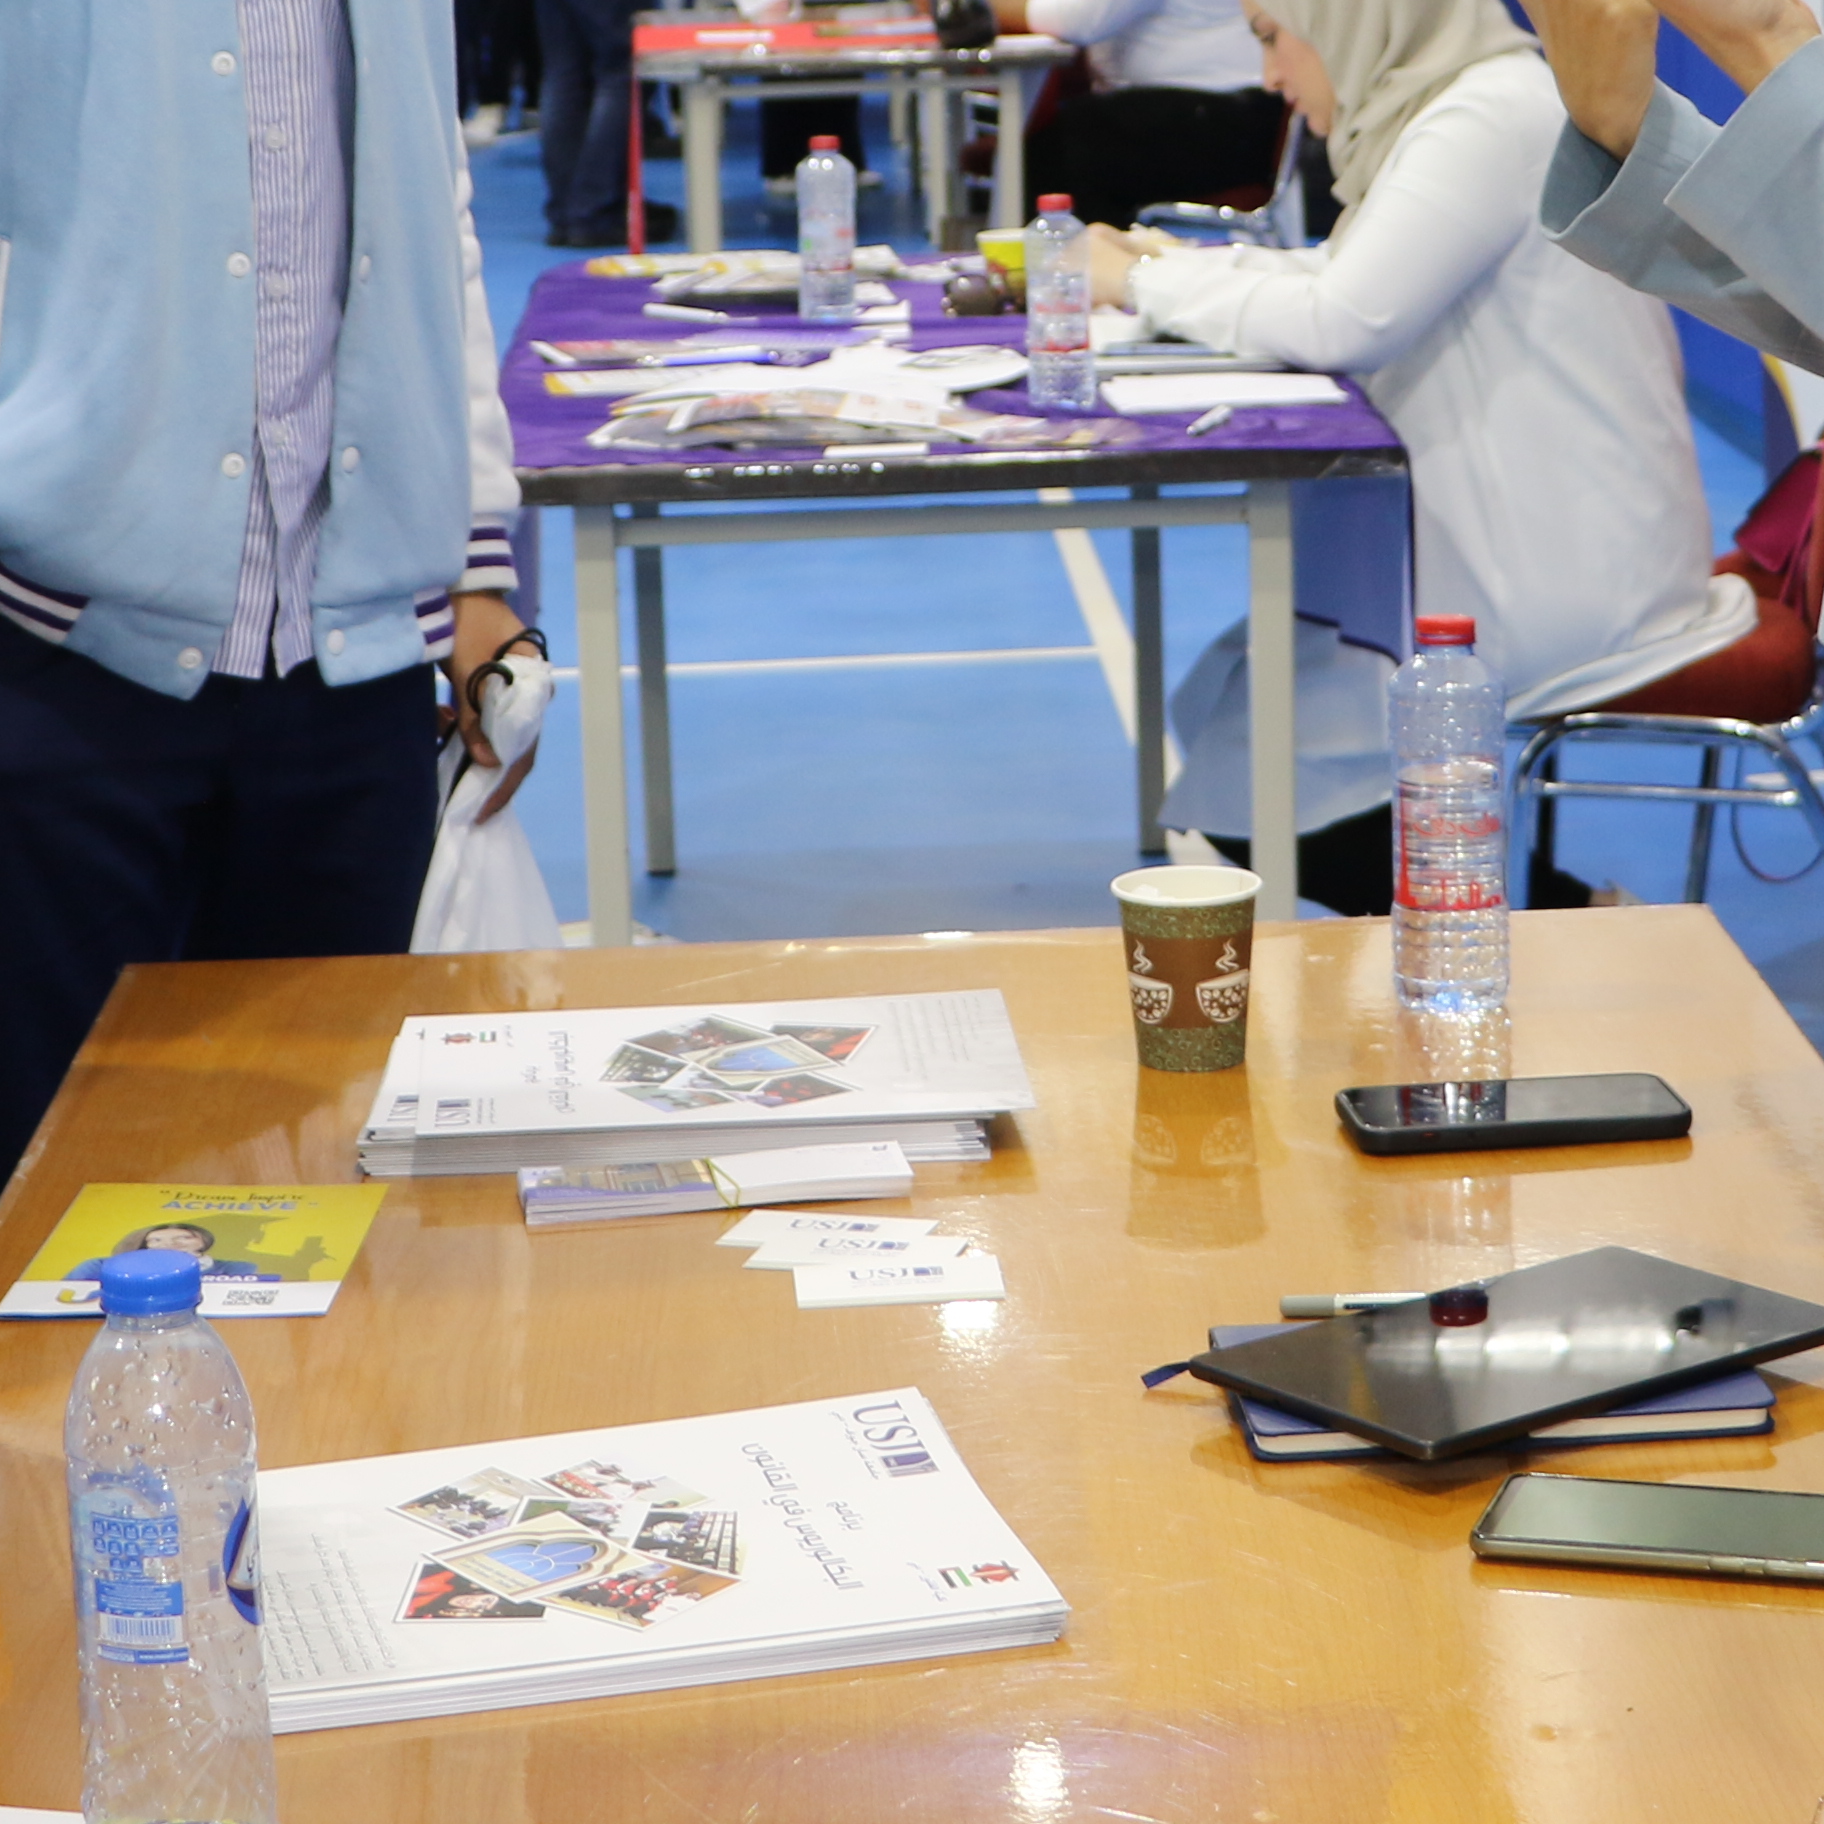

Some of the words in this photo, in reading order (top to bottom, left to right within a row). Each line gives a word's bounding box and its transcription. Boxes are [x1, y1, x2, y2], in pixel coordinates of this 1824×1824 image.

[161, 1201, 297, 1210] ACHIEVE
[789, 1218, 850, 1231] USJ
[817, 1237, 878, 1250] USJ
[849, 1266, 908, 1281] USJ
[852, 1399, 926, 1452] USJ
[741, 1442, 798, 1492] القانون
[762, 1492, 812, 1516] في
[827, 1500, 865, 1531] برنامج
[784, 1516, 864, 1590] البكالوريوس
